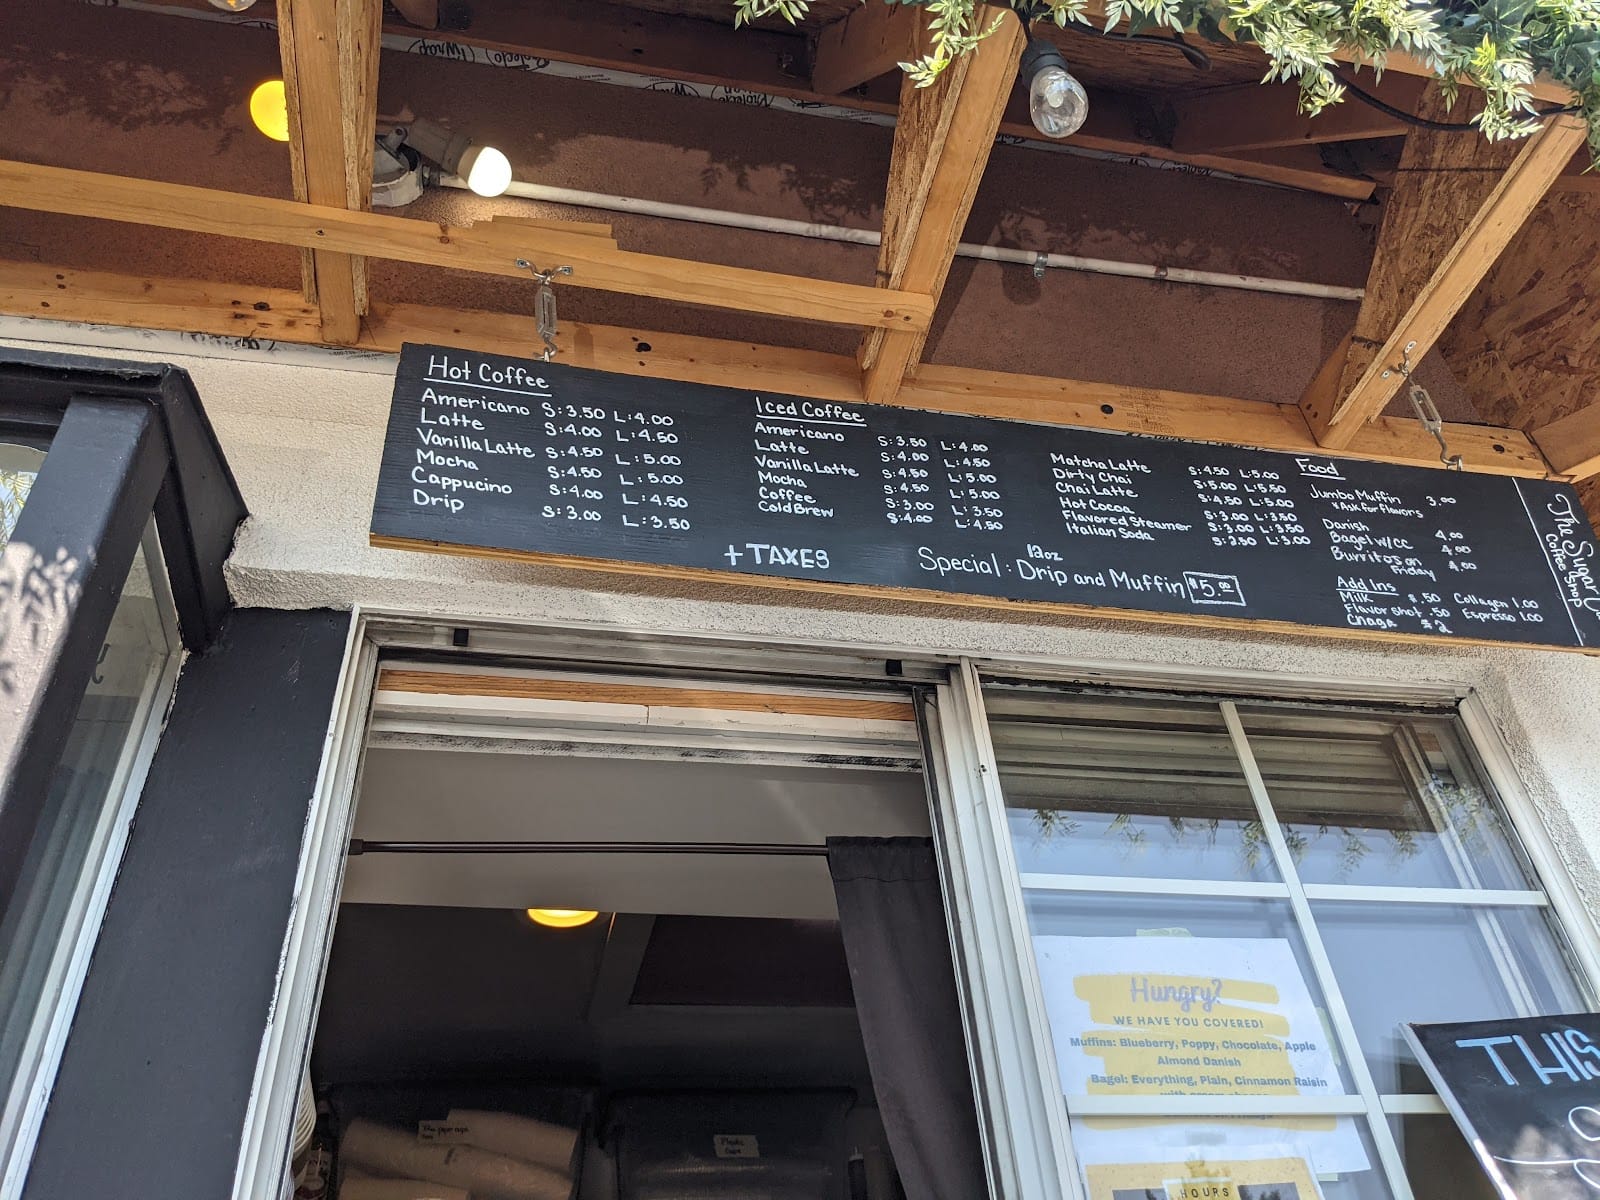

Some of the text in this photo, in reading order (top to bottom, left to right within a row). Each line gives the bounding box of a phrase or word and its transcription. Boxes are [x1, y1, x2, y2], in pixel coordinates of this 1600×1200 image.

[427, 354, 549, 389] Hot Coffee
[421, 387, 530, 415] Americano
[756, 396, 865, 423] Iced Coffee
[421, 407, 485, 431] Latte
[754, 422, 845, 442] Americano
[755, 439, 809, 454] Latte
[416, 449, 479, 471] Mocha
[1295, 458, 1340, 477] Food
[411, 467, 513, 494] Cappucino
[758, 470, 808, 488] Mocha
[1053, 468, 1096, 484] Dirty
[1098, 472, 1133, 484] Chai
[759, 486, 817, 503] Coffee
[1055, 481, 1091, 495] Chai
[1092, 486, 1138, 498] Latte
[1310, 484, 1457, 507] Jumbo Muffin 3.00
[413, 489, 464, 513] Drip
[1059, 497, 1087, 510] Hot
[1089, 499, 1135, 514] Cocoa
[1062, 510, 1128, 526] Flavored
[1129, 516, 1192, 532] Steamer
[1547, 493, 1581, 537] The
[1066, 522, 1117, 538] Italian
[1119, 528, 1155, 541] Soda
[1322, 518, 1370, 532] Danish
[1330, 530, 1373, 551] Bagel
[1330, 545, 1402, 565] Burritos
[1546, 534, 1567, 571] Coffee
[1390, 565, 1437, 582] Friday
[1562, 541, 1600, 596] Sugar
[1017, 559, 1068, 587] Drip
[1074, 572, 1107, 589] and
[1109, 569, 1186, 600] Muffin
[1337, 576, 1397, 592] Add Ins
[1339, 591, 1374, 604] Milk
[1453, 593, 1509, 612] Collagen
[1344, 603, 1388, 617] Flavor
[1461, 608, 1517, 623] Espresso
[1131, 977, 1223, 1013] Hungry?
[1113, 1015, 1264, 1029] WE HAVE YOU COVERED!
[1070, 1037, 1316, 1053] Muffins: Blueberry, Poppy, Chocolate, Apple
[1157, 1056, 1242, 1067] Almond Danish
[1455, 1029, 1600, 1086] THIS
[1091, 1074, 1328, 1088] Bagel: Everything, Plain, Cinnamon Raisin
[1180, 1187, 1229, 1199] HOURS
